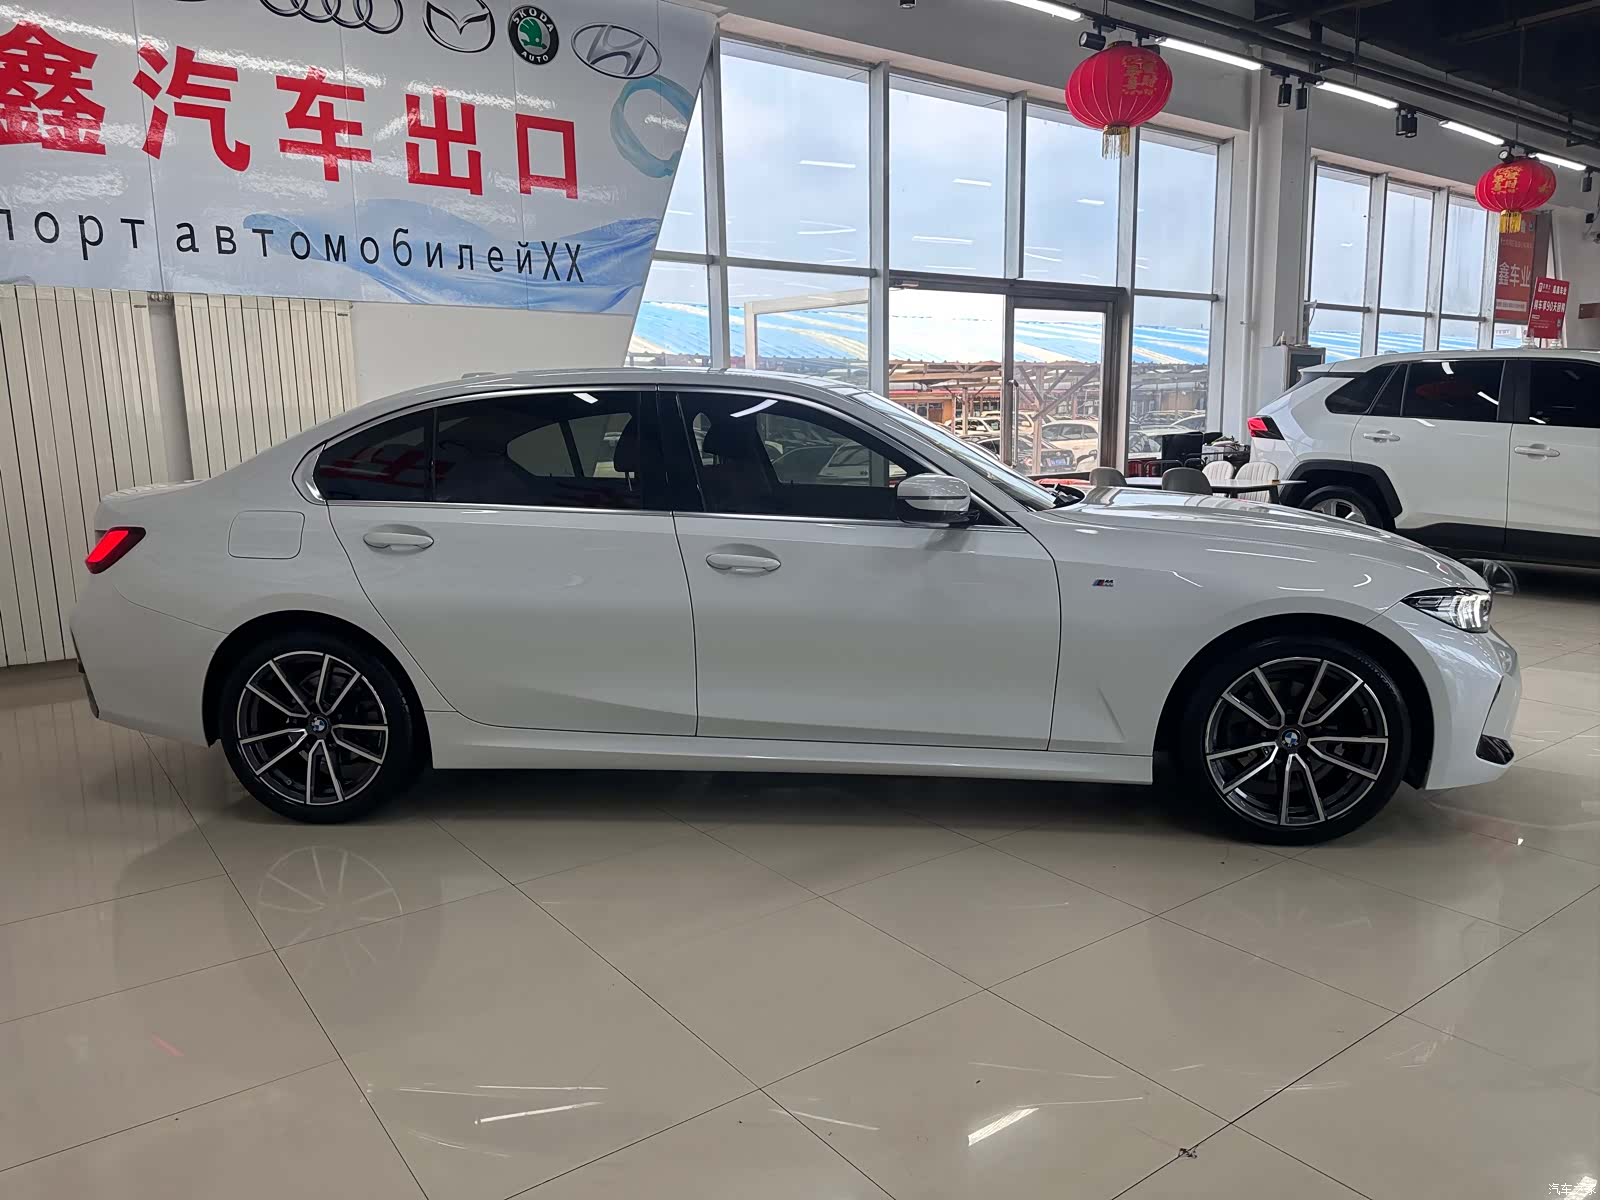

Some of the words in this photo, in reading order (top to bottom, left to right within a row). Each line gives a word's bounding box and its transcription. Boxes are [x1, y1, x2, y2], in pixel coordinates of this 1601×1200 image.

[512, 8, 554, 32] SKODA
[521, 51, 549, 63] AUTO
[0, 20, 578, 199] 鑫汽车出口
